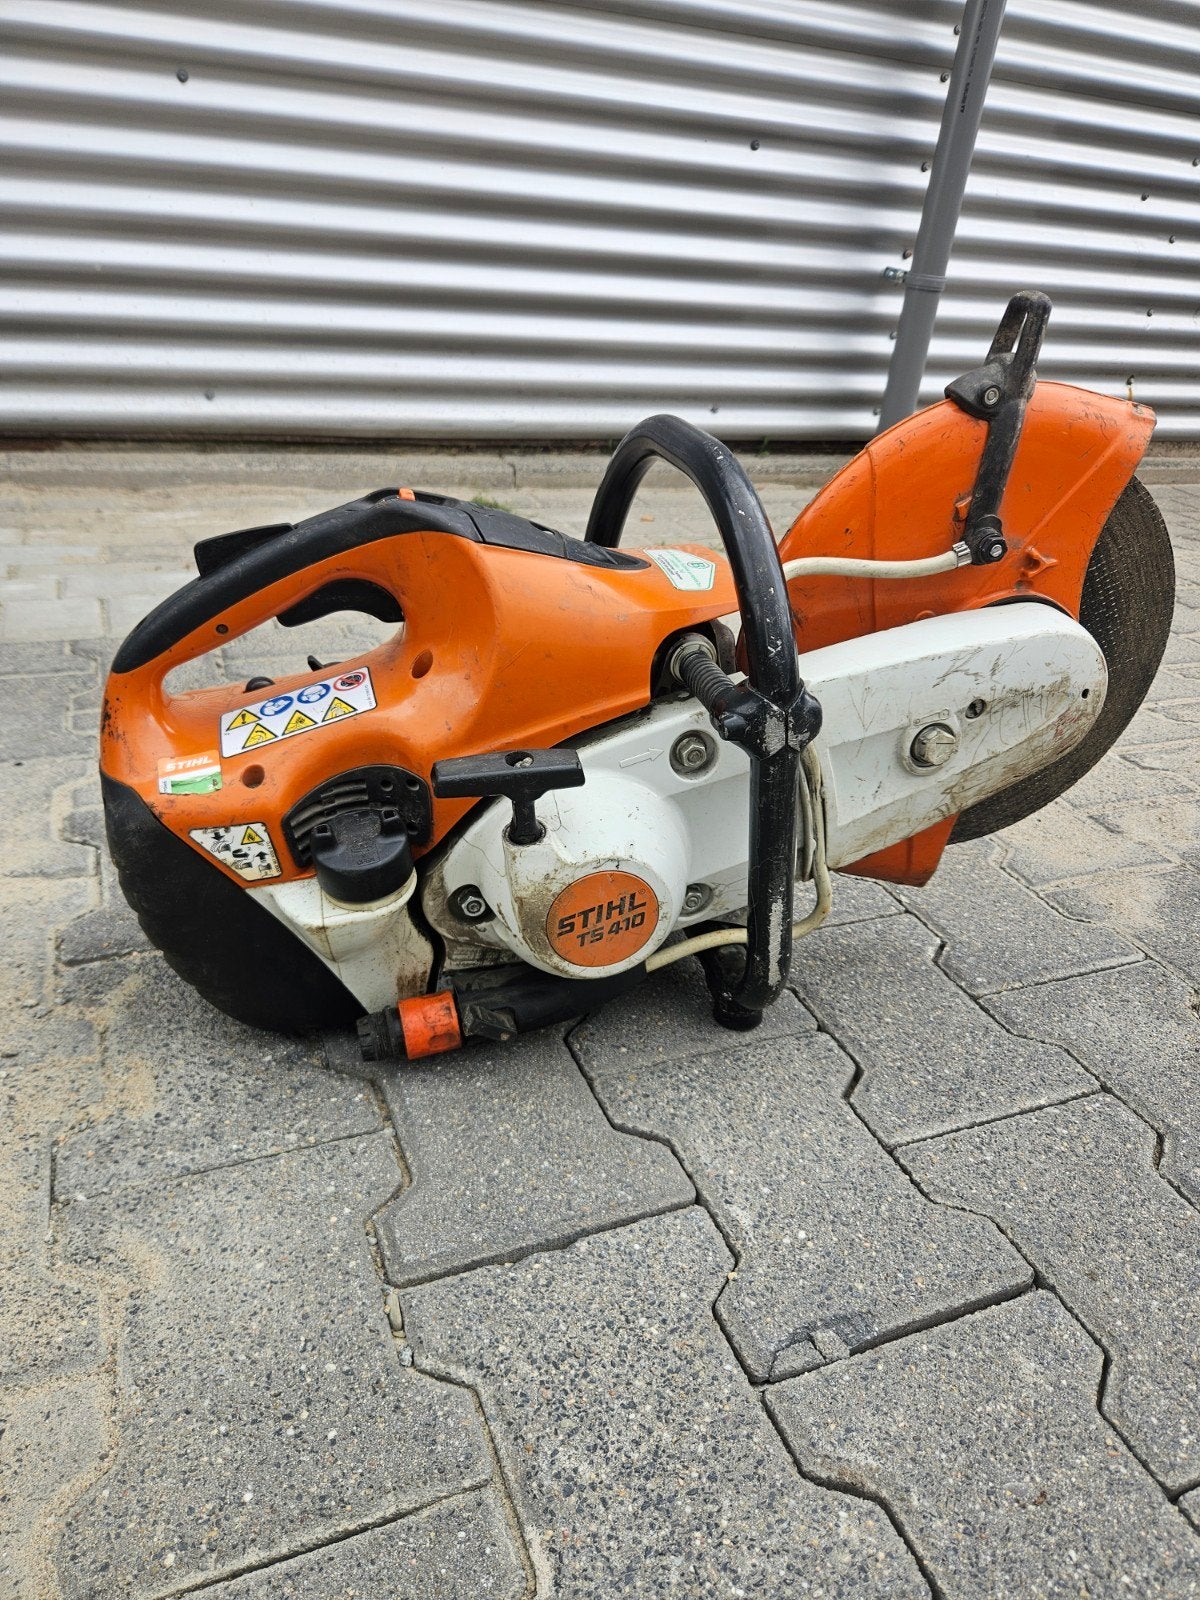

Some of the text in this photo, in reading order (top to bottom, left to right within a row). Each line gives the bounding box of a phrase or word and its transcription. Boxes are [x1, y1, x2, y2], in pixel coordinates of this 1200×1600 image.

[166, 756, 213, 771] STIHL
[557, 892, 647, 938] STIHL
[576, 911, 646, 947] TS 410
